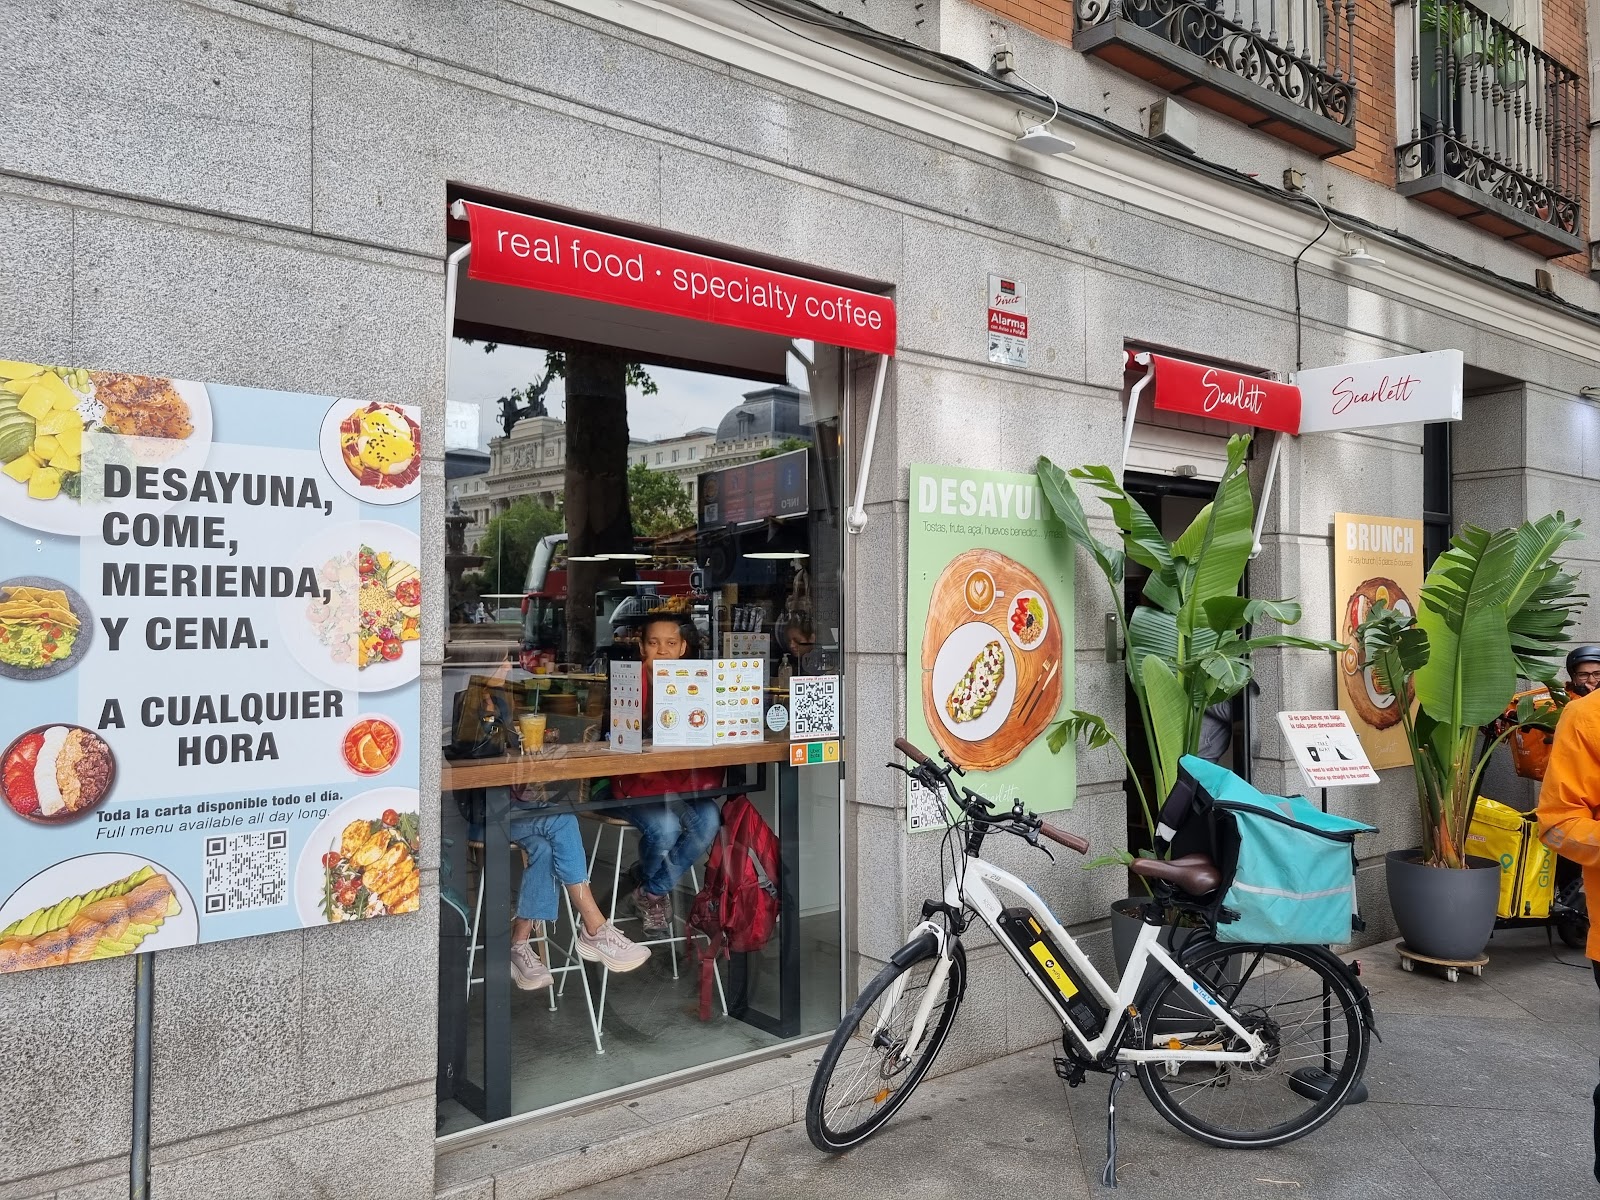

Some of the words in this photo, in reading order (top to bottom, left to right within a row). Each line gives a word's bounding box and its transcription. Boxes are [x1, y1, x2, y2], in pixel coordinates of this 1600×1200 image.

[497, 229, 560, 265] real
[570, 239, 643, 283] food
[672, 266, 797, 318] specialty
[805, 296, 882, 330] coffee
[991, 312, 1026, 330] Alarma
[1202, 369, 1266, 414] Scarlett
[1332, 375, 1421, 416] Scarlett
[103, 463, 333, 517] DESAYUNA,
[102, 511, 239, 557] COME,
[922, 520, 948, 533] Tostas,
[984, 525, 1009, 536] huevos
[1346, 522, 1414, 554] BRUNCH
[102, 562, 332, 605] MERIENDA,
[100, 617, 129, 651] Y
[145, 616, 269, 651] CENA.
[97, 698, 126, 730] A
[140, 690, 344, 727] CUALQUIER
[178, 731, 280, 767] HORA
[96, 809, 131, 822] Toda
[136, 807, 149, 819] la
[154, 803, 192, 817] carta
[197, 797, 268, 814] disponible
[272, 794, 301, 806] todo
[304, 792, 316, 803] el
[320, 790, 343, 802] día.
[96, 825, 126, 840] Full
[130, 824, 174, 837] menu
[178, 814, 243, 832] available
[248, 812, 265, 824] all
[268, 810, 294, 823] day
[298, 808, 330, 820] long.
